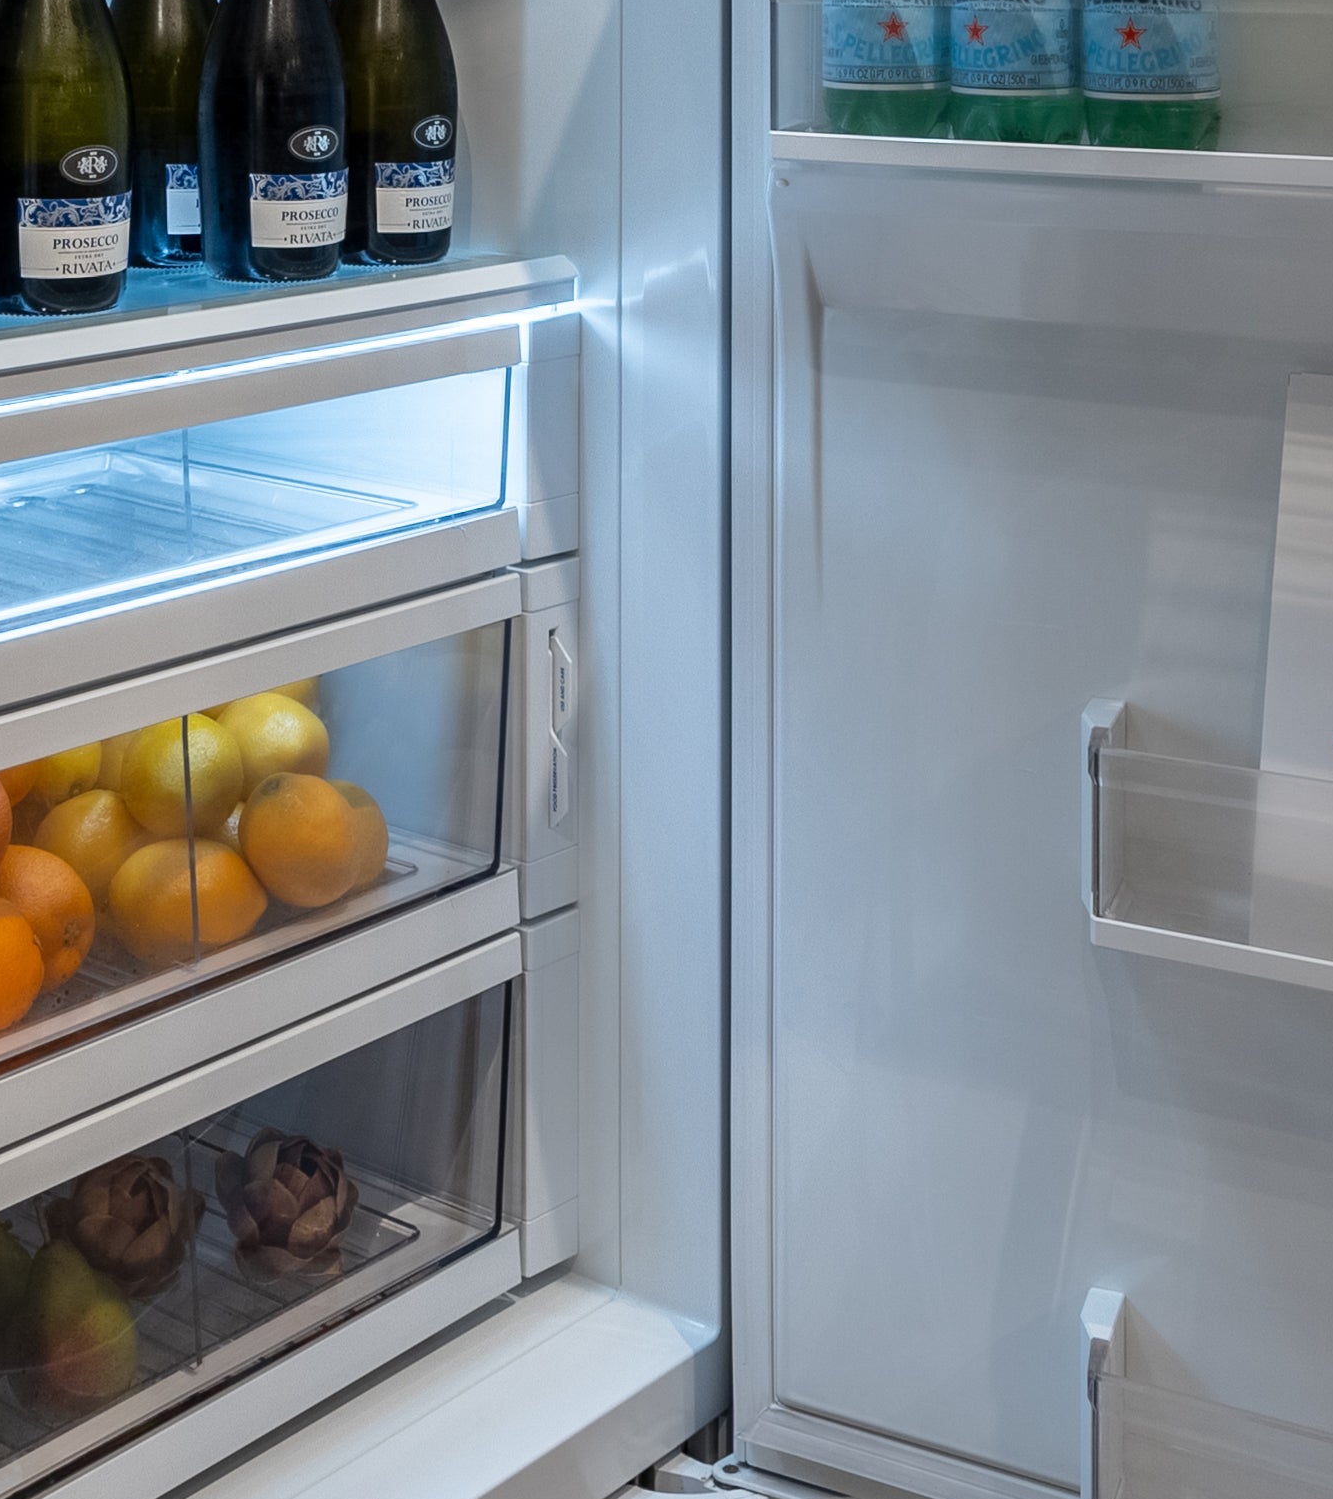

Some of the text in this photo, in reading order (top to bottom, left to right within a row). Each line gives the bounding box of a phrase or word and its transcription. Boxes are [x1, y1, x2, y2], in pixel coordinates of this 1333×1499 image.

[405, 192, 452, 208] PROSECCO
[281, 206, 339, 221] PROSECCO
[412, 215, 449, 230] RIVATA
[52, 233, 119, 250] PROSECCO
[289, 231, 334, 245] RIVATA
[61, 260, 114, 275] RIVATA
